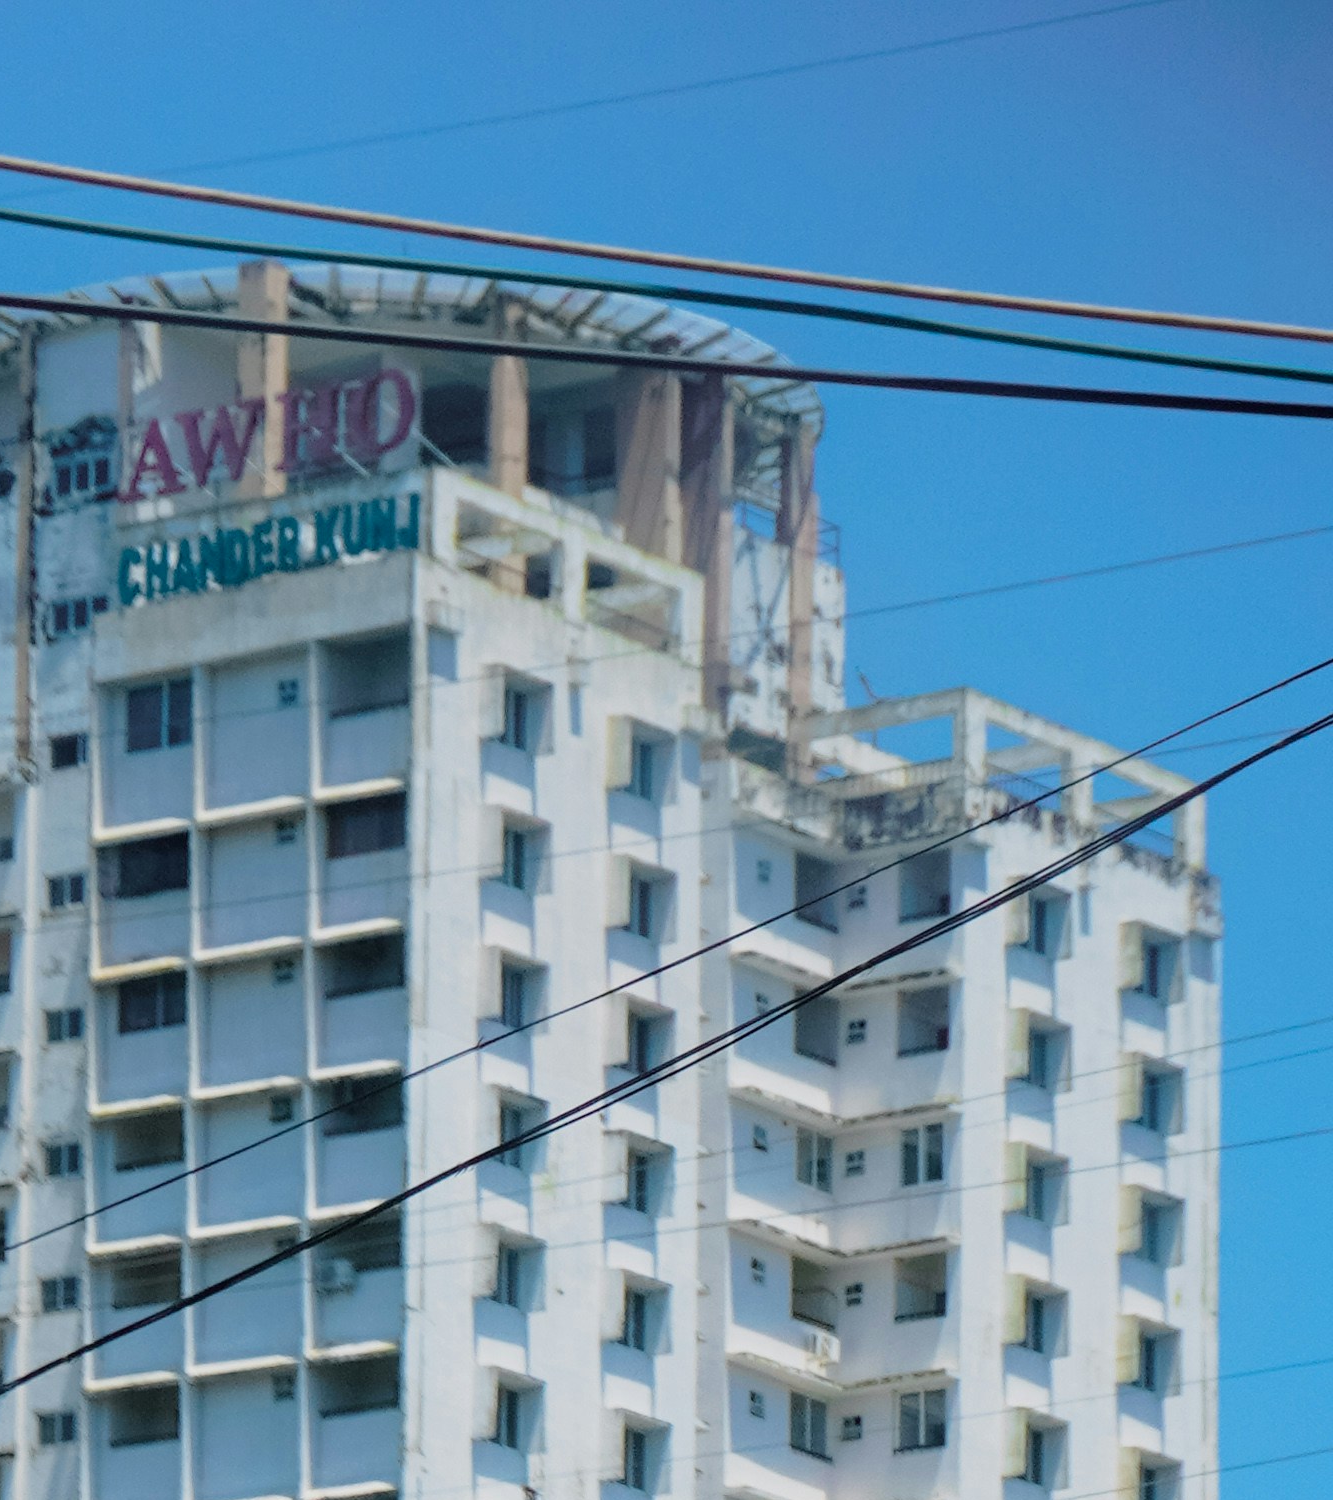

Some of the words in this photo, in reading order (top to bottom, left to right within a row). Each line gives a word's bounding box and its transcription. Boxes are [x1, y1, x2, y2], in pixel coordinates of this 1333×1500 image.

[119, 368, 417, 503] AWHO
[118, 516, 300, 606] CHANDER
[313, 493, 421, 567] KUNJ
